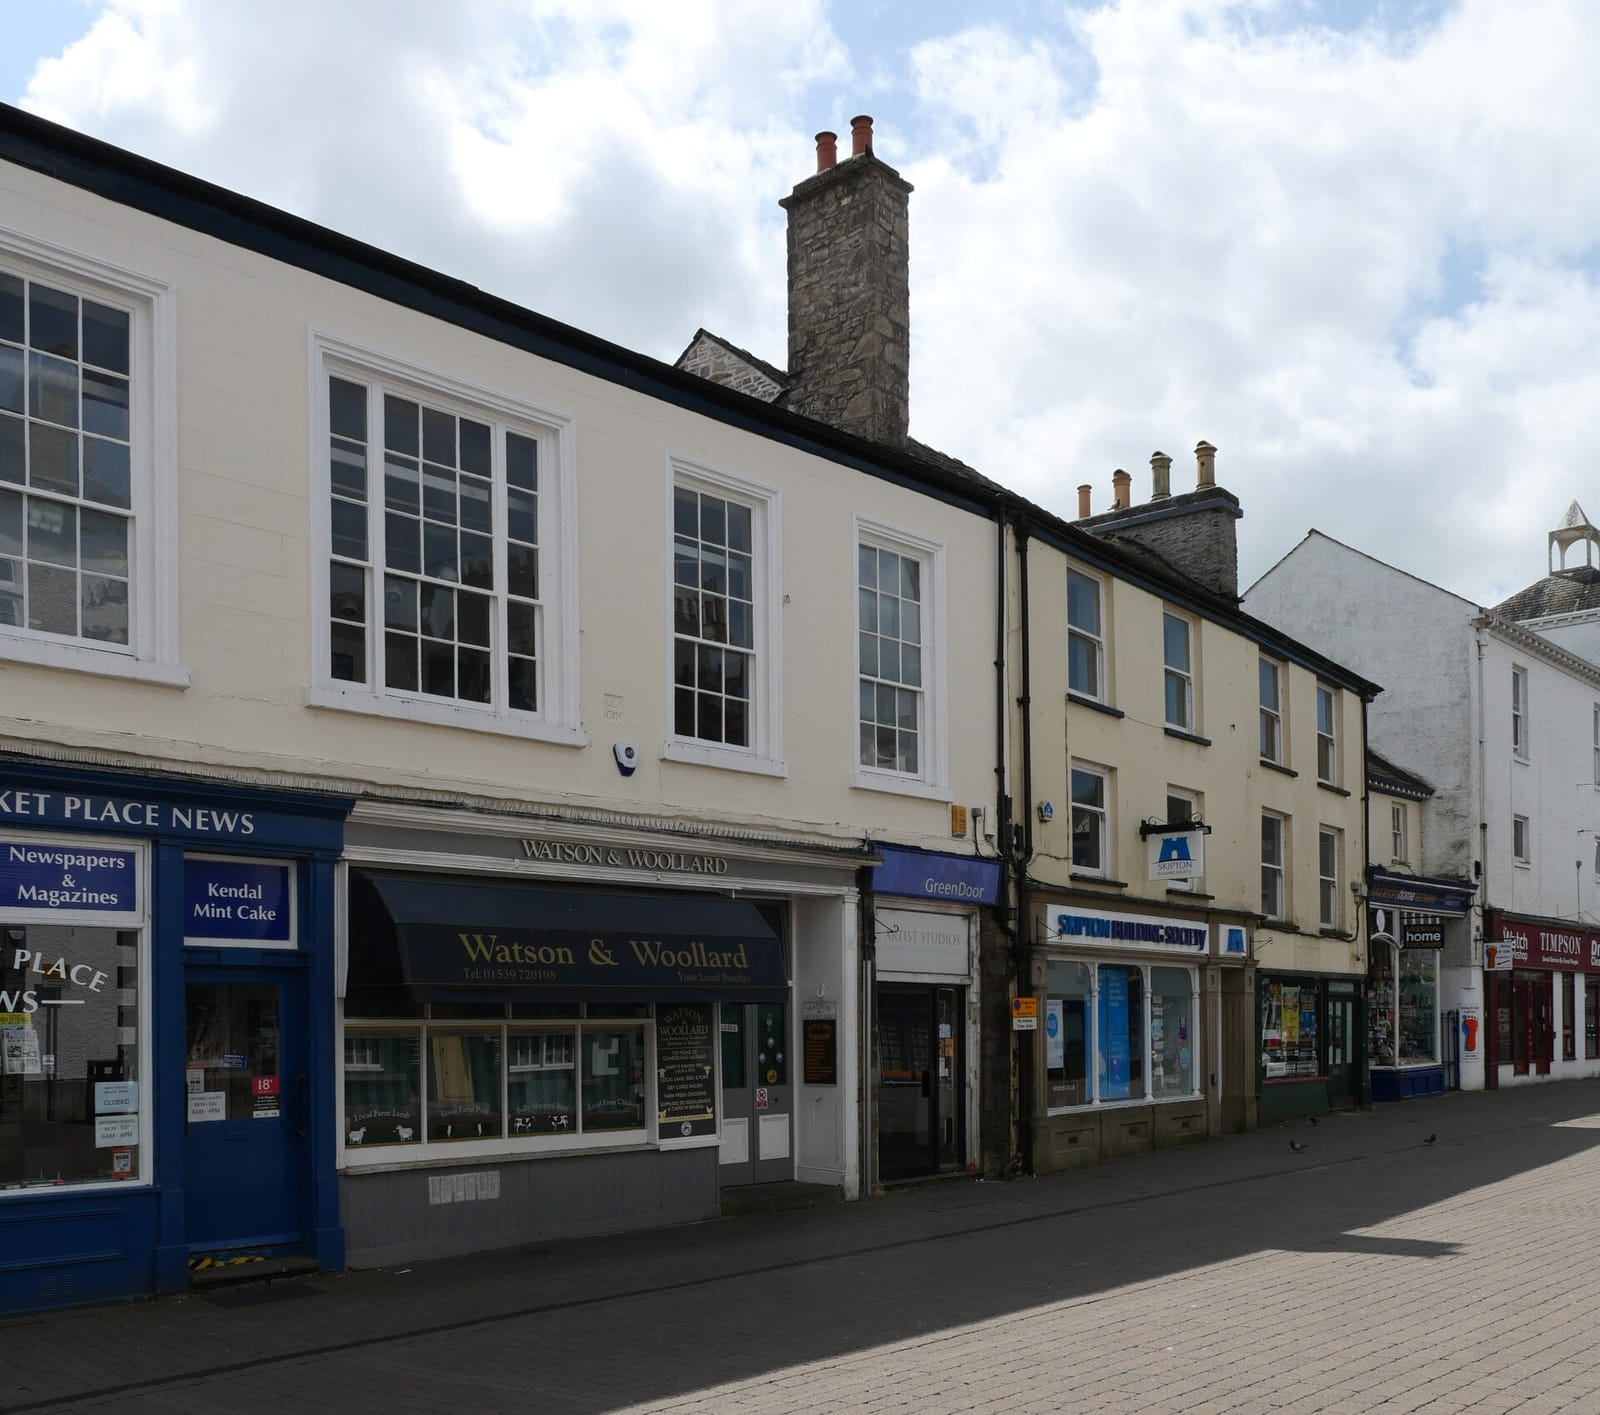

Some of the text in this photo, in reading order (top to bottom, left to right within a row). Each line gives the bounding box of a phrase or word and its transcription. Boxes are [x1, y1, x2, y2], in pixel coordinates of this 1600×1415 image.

[64, 797, 159, 826] PLACE
[172, 807, 254, 834] NEWS
[9, 847, 125, 871] Newspapers
[520, 839, 728, 875] WATSON & WOOLLARD
[1158, 862, 1192, 871] SKIPTON
[62, 874, 75, 887] &
[925, 878, 985, 898] GreenDoor
[18, 884, 118, 907] Magazines
[208, 883, 262, 899] Kendal
[194, 904, 276, 921] Mint Cake
[885, 929, 961, 946] ARTIST STUDIOS
[1058, 914, 1207, 950] SKIPTON BUILDING SOCIETY
[1406, 932, 1440, 942] home
[458, 933, 749, 969] Watson & Woollard
[1540, 932, 1582, 955] TIMPSON
[13, 949, 109, 992] PLACE
[483, 968, 516, 980] 01539
[663, 1008, 704, 1024] WATSON
[659, 1025, 709, 1036] WOOLLARD
[353, 1110, 373, 1122] Local
